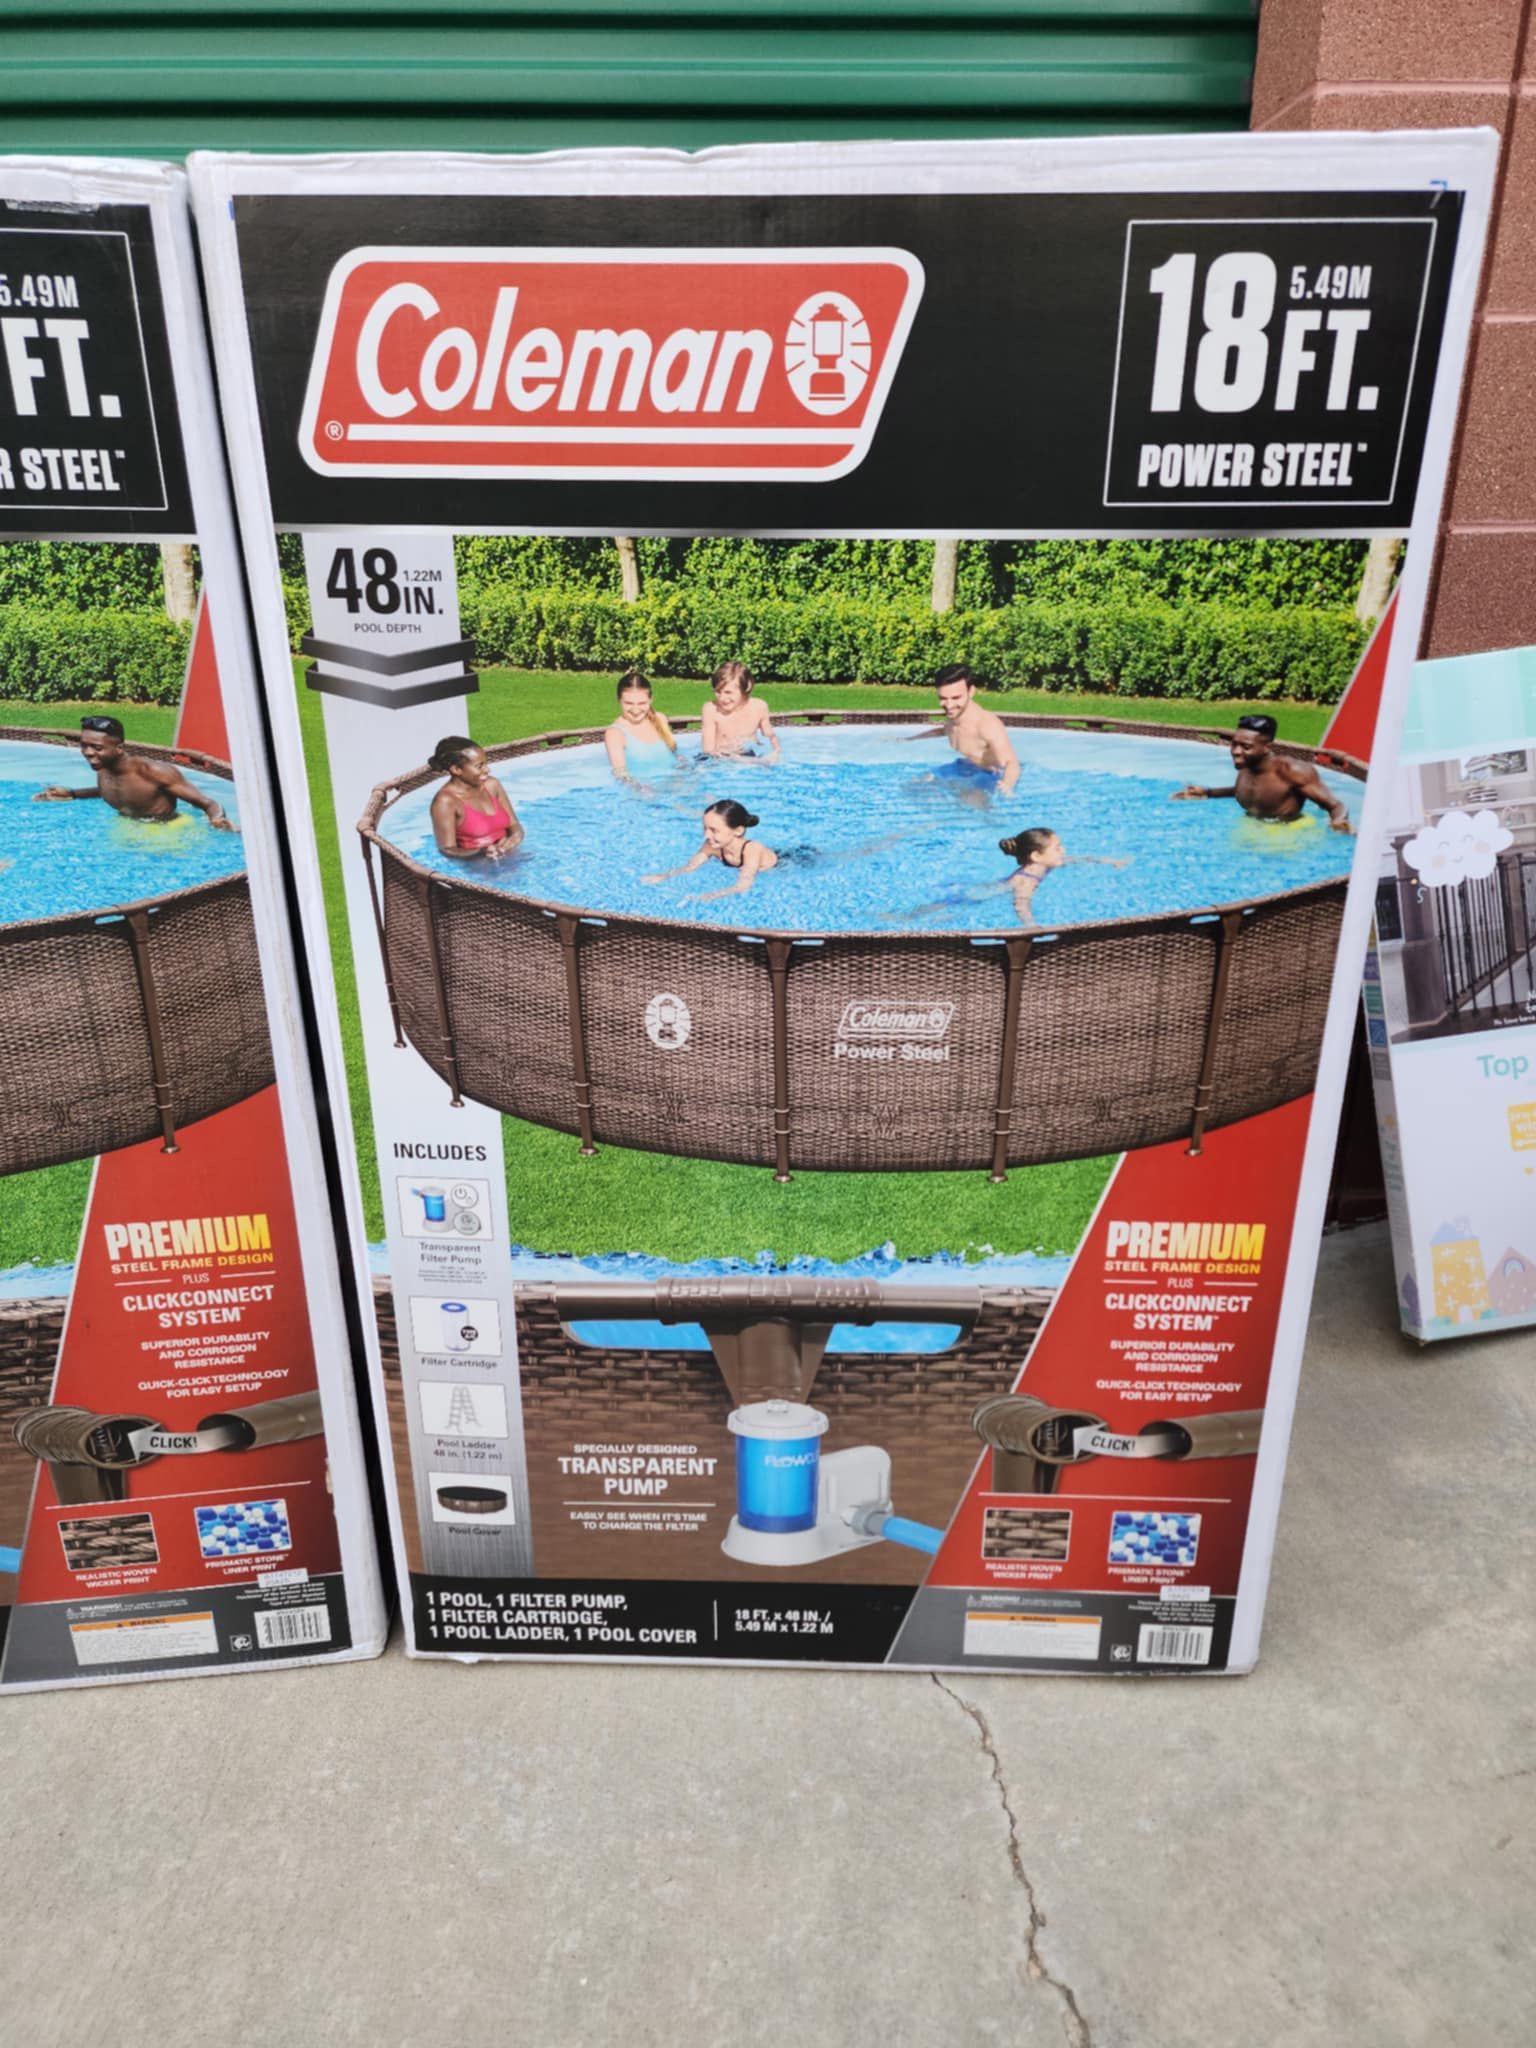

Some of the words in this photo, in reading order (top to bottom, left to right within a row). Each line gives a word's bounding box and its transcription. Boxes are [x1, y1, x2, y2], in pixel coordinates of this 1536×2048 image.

[1289, 265, 1373, 299] 5.49M
[1149, 252, 1278, 413] 18
[356, 282, 773, 418] Coleman
[0, 317, 122, 418] FT.
[1274, 309, 1380, 411] FT.
[1137, 443, 1255, 488] POWER
[327, 547, 401, 615] 48
[403, 570, 442, 582] 1.22M
[404, 586, 444, 615] IN.
[354, 623, 383, 633] POOL
[386, 623, 422, 634] DEPTH
[850, 1006, 928, 1029] Coleman
[834, 1043, 897, 1060] Power
[901, 1043, 951, 1062] Steel
[1476, 1054, 1529, 1080] Top
[393, 1142, 488, 1162] INCLUDES
[104, 1213, 271, 1261] PREMIUM
[1106, 1220, 1266, 1260] PREMIUM
[419, 1241, 482, 1254] Transparent
[111, 1262, 158, 1274] STEEL
[162, 1257, 213, 1271] FRAME
[218, 1252, 274, 1266] DESIGN
[420, 1253, 447, 1264] Filter
[450, 1254, 482, 1266] Pump
[1104, 1261, 1148, 1272] STEEL
[1152, 1261, 1201, 1273] FRAME
[1206, 1263, 1261, 1275] DESIGN
[182, 1273, 210, 1285] PLUS
[1167, 1278, 1194, 1288] PLUS
[122, 1284, 274, 1312] CLICKCONNECT
[1105, 1293, 1253, 1312] CLICKCONNECT
[140, 1337, 201, 1351] SUPERIOR
[203, 1331, 271, 1345] DURABILITY
[1110, 1340, 1167, 1350] SUPERIOR
[1168, 1341, 1235, 1352] DURABILITY
[159, 1350, 185, 1360] AND
[187, 1344, 257, 1357] CORROSION
[1124, 1352, 1149, 1361] AND
[1151, 1353, 1218, 1363] CORROSION
[174, 1355, 246, 1369] RESISTANCE
[421, 1358, 448, 1367] Filter
[450, 1358, 498, 1369] Cartridge
[1136, 1363, 1204, 1373] RESISTANCE
[138, 1376, 212, 1391] QUICK-CLICK
[212, 1368, 289, 1383] TECHNOLOGY
[1096, 1380, 1166, 1390] QUICK-CLICK
[1167, 1381, 1242, 1392] TECHNOLOGY
[167, 1389, 191, 1399] FOR
[193, 1386, 222, 1396] EASY
[225, 1382, 262, 1394] SETUP
[1120, 1391, 1143, 1400] FOR
[1145, 1392, 1174, 1401] EASY
[1176, 1392, 1213, 1402] SETUP
[150, 1436, 198, 1449] CLICK!
[437, 1439, 460, 1449] Pool
[461, 1439, 496, 1450] Ladder
[574, 1444, 634, 1454] SPECIALLY
[637, 1444, 698, 1454] DESIGNED
[1091, 1436, 1136, 1451] CLICK!
[557, 1457, 718, 1476] TRANSPARENT
[604, 1478, 668, 1495] PUMP
[570, 1512, 605, 1521] EASILY
[607, 1512, 626, 1521] SEE
[628, 1512, 661, 1521] WHEN
[682, 1513, 708, 1522] TIME
[582, 1521, 598, 1529] TO
[599, 1522, 643, 1530] CHANGE
[644, 1522, 663, 1530] THE
[665, 1522, 699, 1531] FILTER
[426, 1591, 434, 1605] 1
[440, 1592, 492, 1609] POOL,
[495, 1593, 504, 1607] 1
[510, 1594, 567, 1608] FILTER
[571, 1595, 628, 1611] PUMP,
[428, 1609, 436, 1622] 1
[442, 1609, 499, 1623] FILTER
[502, 1610, 608, 1627] CARTRIDGE,
[735, 1610, 750, 1620] 18
[753, 1610, 771, 1620] FT.
[774, 1612, 782, 1620] x
[785, 1610, 801, 1621] 48
[803, 1610, 822, 1621] IN.
[824, 1611, 831, 1622] /
[429, 1625, 438, 1639] 1
[444, 1625, 492, 1641] POOL
[495, 1626, 570, 1643] LADDER,
[574, 1628, 583, 1641] 1
[587, 1628, 636, 1642] POOL
[638, 1629, 697, 1644] COVER
[735, 1621, 761, 1631] 5.49
[764, 1621, 777, 1632] M
[780, 1624, 788, 1632] x
[791, 1622, 818, 1633] 1.22
[820, 1622, 833, 1633] M
